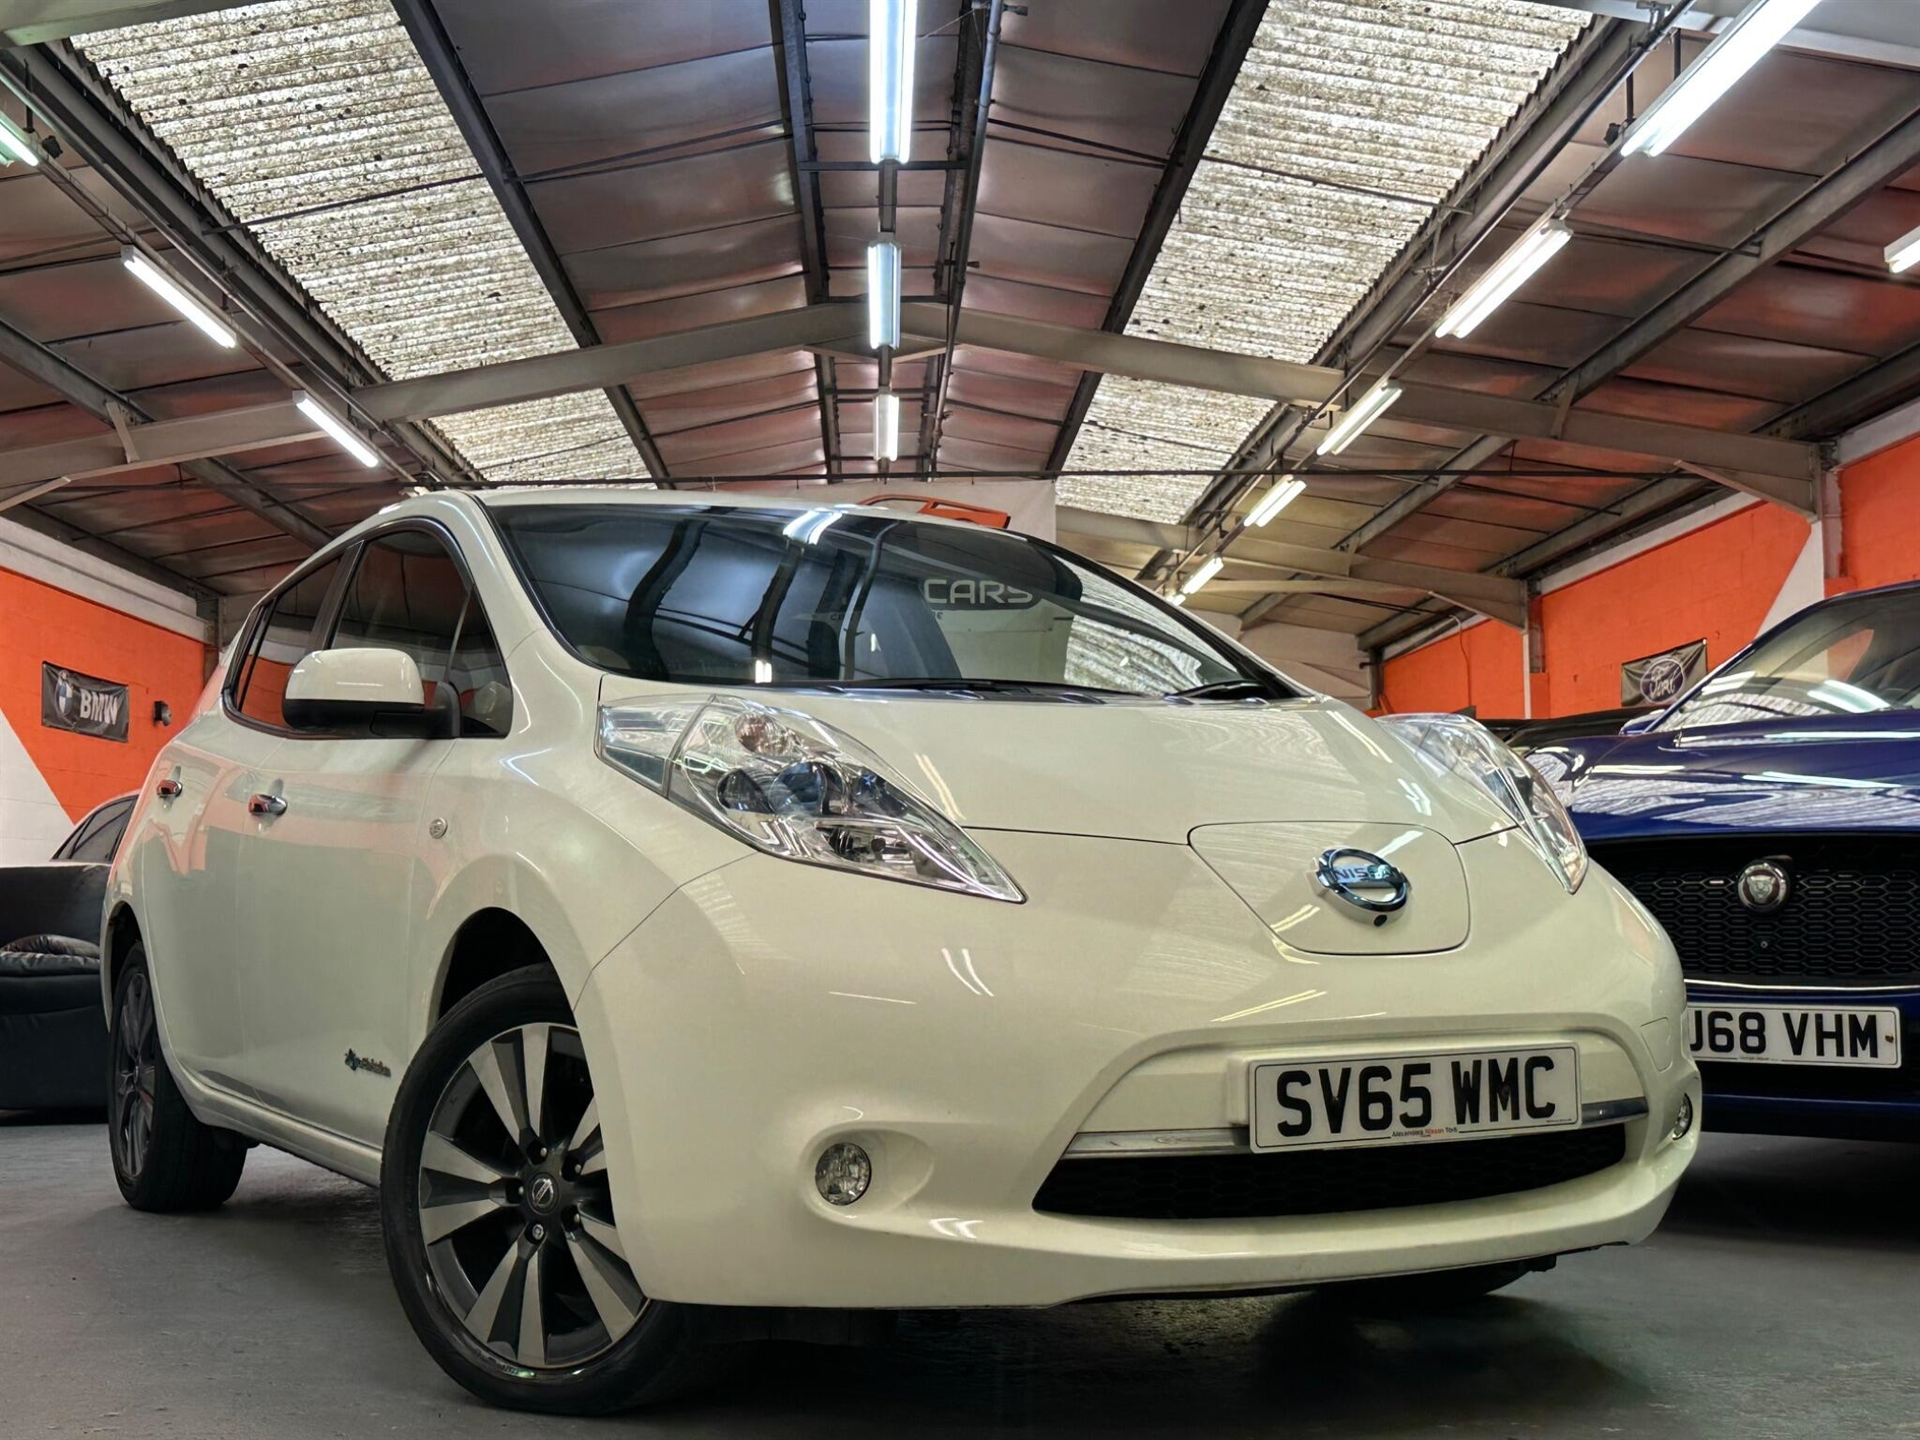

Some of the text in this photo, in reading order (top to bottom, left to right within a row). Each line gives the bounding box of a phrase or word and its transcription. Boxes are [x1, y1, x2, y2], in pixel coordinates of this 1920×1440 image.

[924, 579, 1033, 604] CARS
[79, 688, 118, 725] BMW
[1782, 1012, 1878, 1059] VHM
[1277, 1055, 1555, 1137] SV65 WMC
